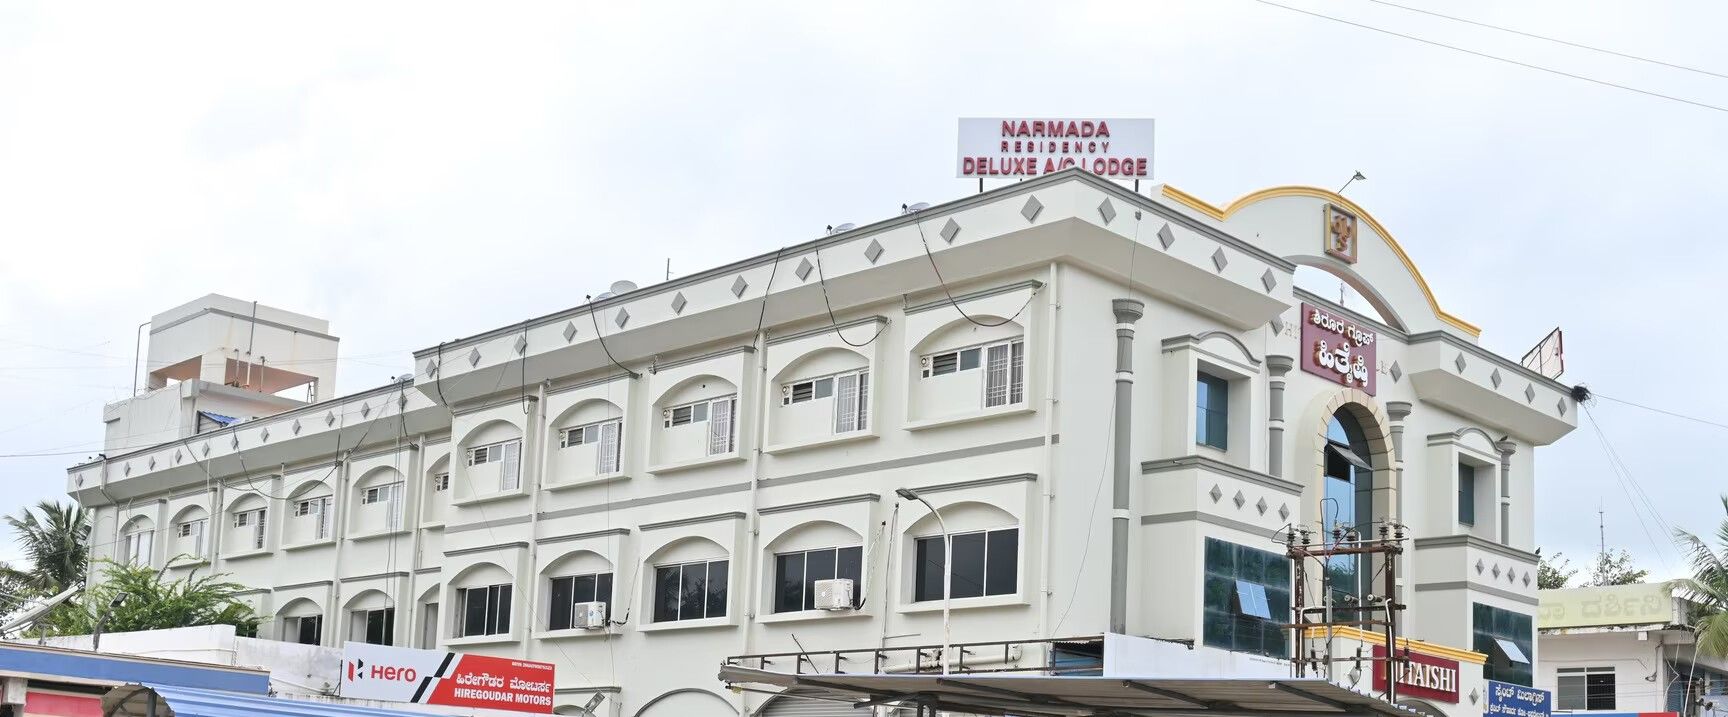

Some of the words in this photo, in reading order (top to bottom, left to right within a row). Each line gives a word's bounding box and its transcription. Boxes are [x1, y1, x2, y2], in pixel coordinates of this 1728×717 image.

[1002, 120, 1110, 138] NARMADA
[1001, 141, 1110, 153] RESIDENCY
[963, 157, 1037, 175] DELUXE
[1317, 340, 1369, 387] ಹಿತೈಷಿ
[370, 664, 417, 682] Hero
[454, 687, 513, 703] HIREGOUDAR
[514, 693, 552, 706] MOTORS
